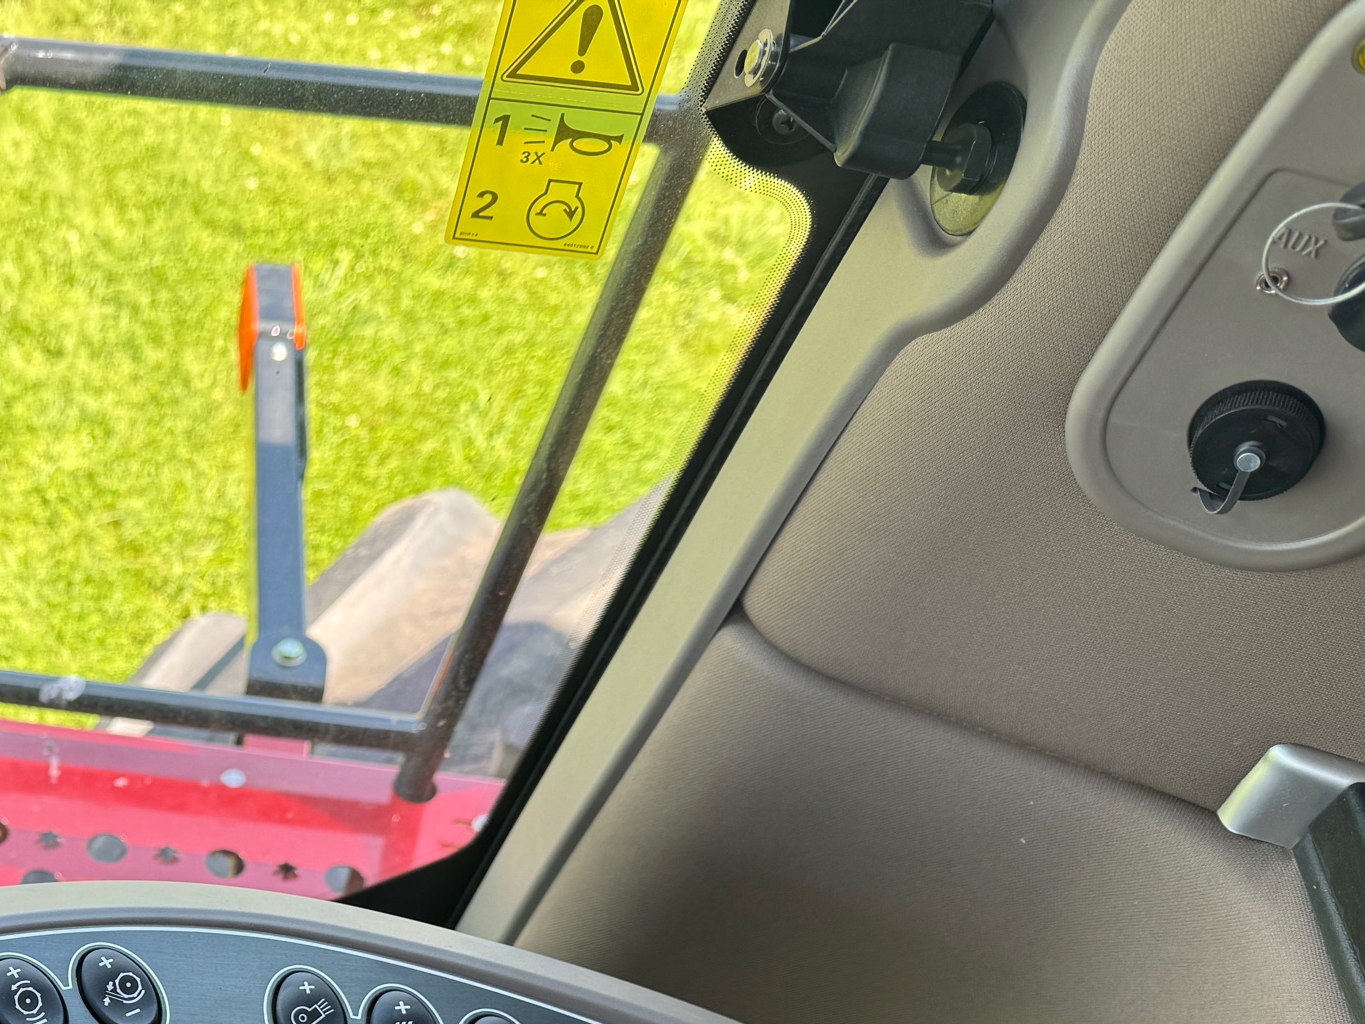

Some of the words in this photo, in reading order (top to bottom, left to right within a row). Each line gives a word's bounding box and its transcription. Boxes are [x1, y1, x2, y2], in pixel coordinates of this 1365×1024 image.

[492, 114, 512, 147] 1
[519, 150, 546, 166] 3X
[470, 190, 499, 221] 2
[1271, 226, 1326, 259] AUX
